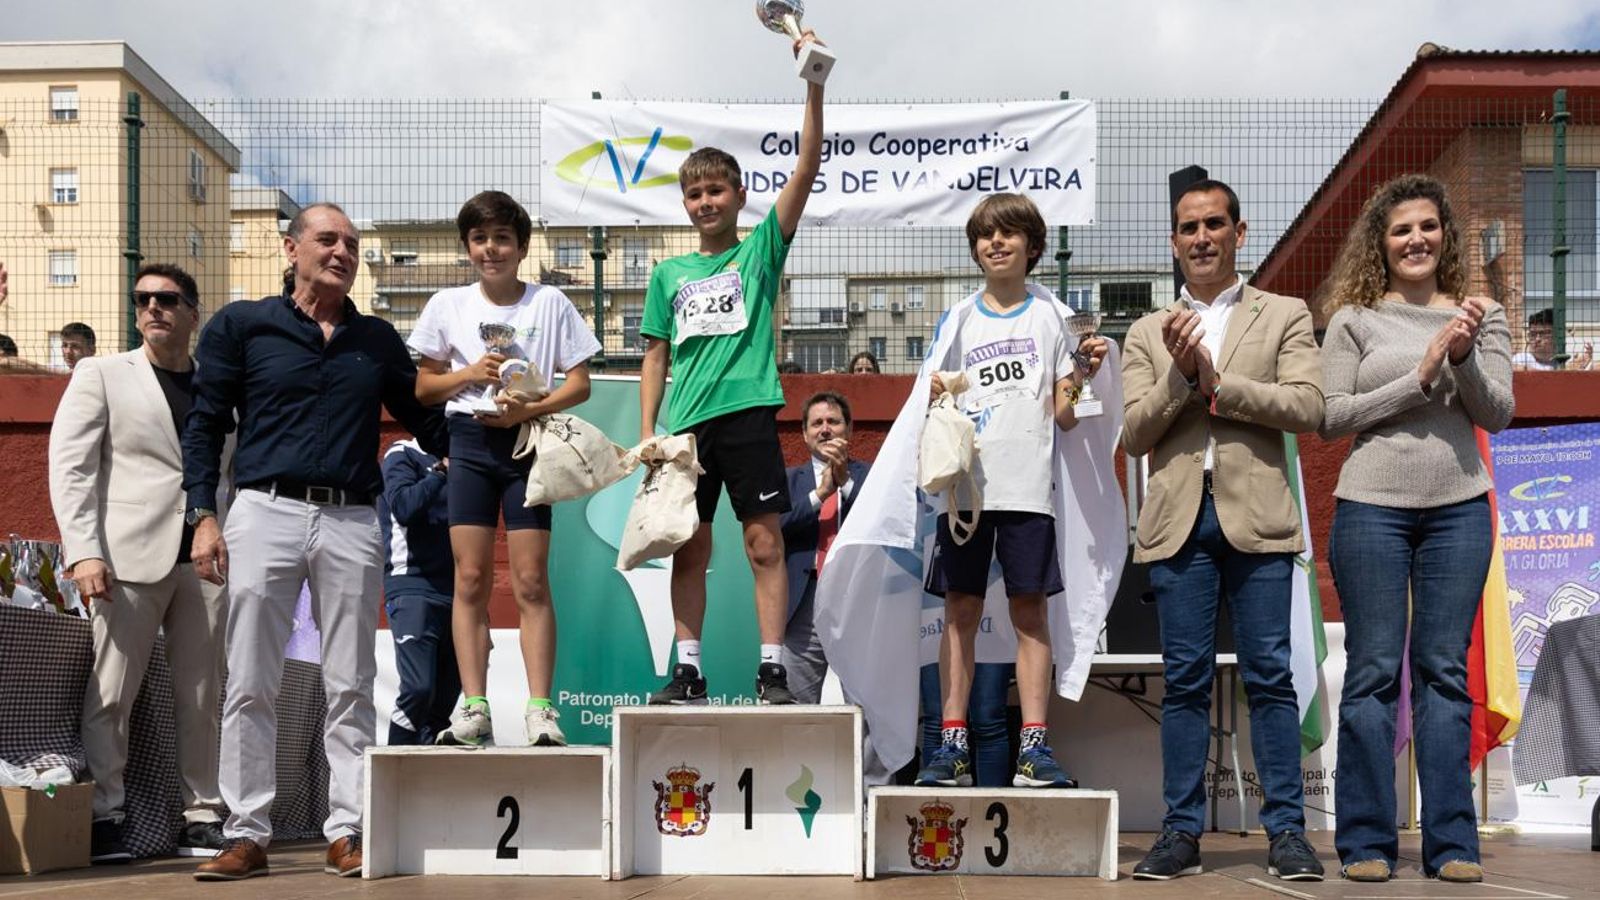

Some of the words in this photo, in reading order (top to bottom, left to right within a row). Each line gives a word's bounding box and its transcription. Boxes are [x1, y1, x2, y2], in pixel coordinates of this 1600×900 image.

[761, 131, 855, 162] Colgio
[869, 131, 1029, 162] Cooperativa
[740, 170, 827, 193] NDRS
[842, 170, 878, 193] DE
[979, 361, 1025, 387] 508
[1501, 535, 1537, 551] RRERA
[1540, 533, 1594, 549] ESCOLAR
[559, 691, 640, 706] Patronato
[581, 711, 613, 728] Dep
[737, 768, 752, 830] 1
[1304, 782, 1330, 796] aén
[496, 796, 520, 859] 2
[984, 801, 1009, 868] 3
